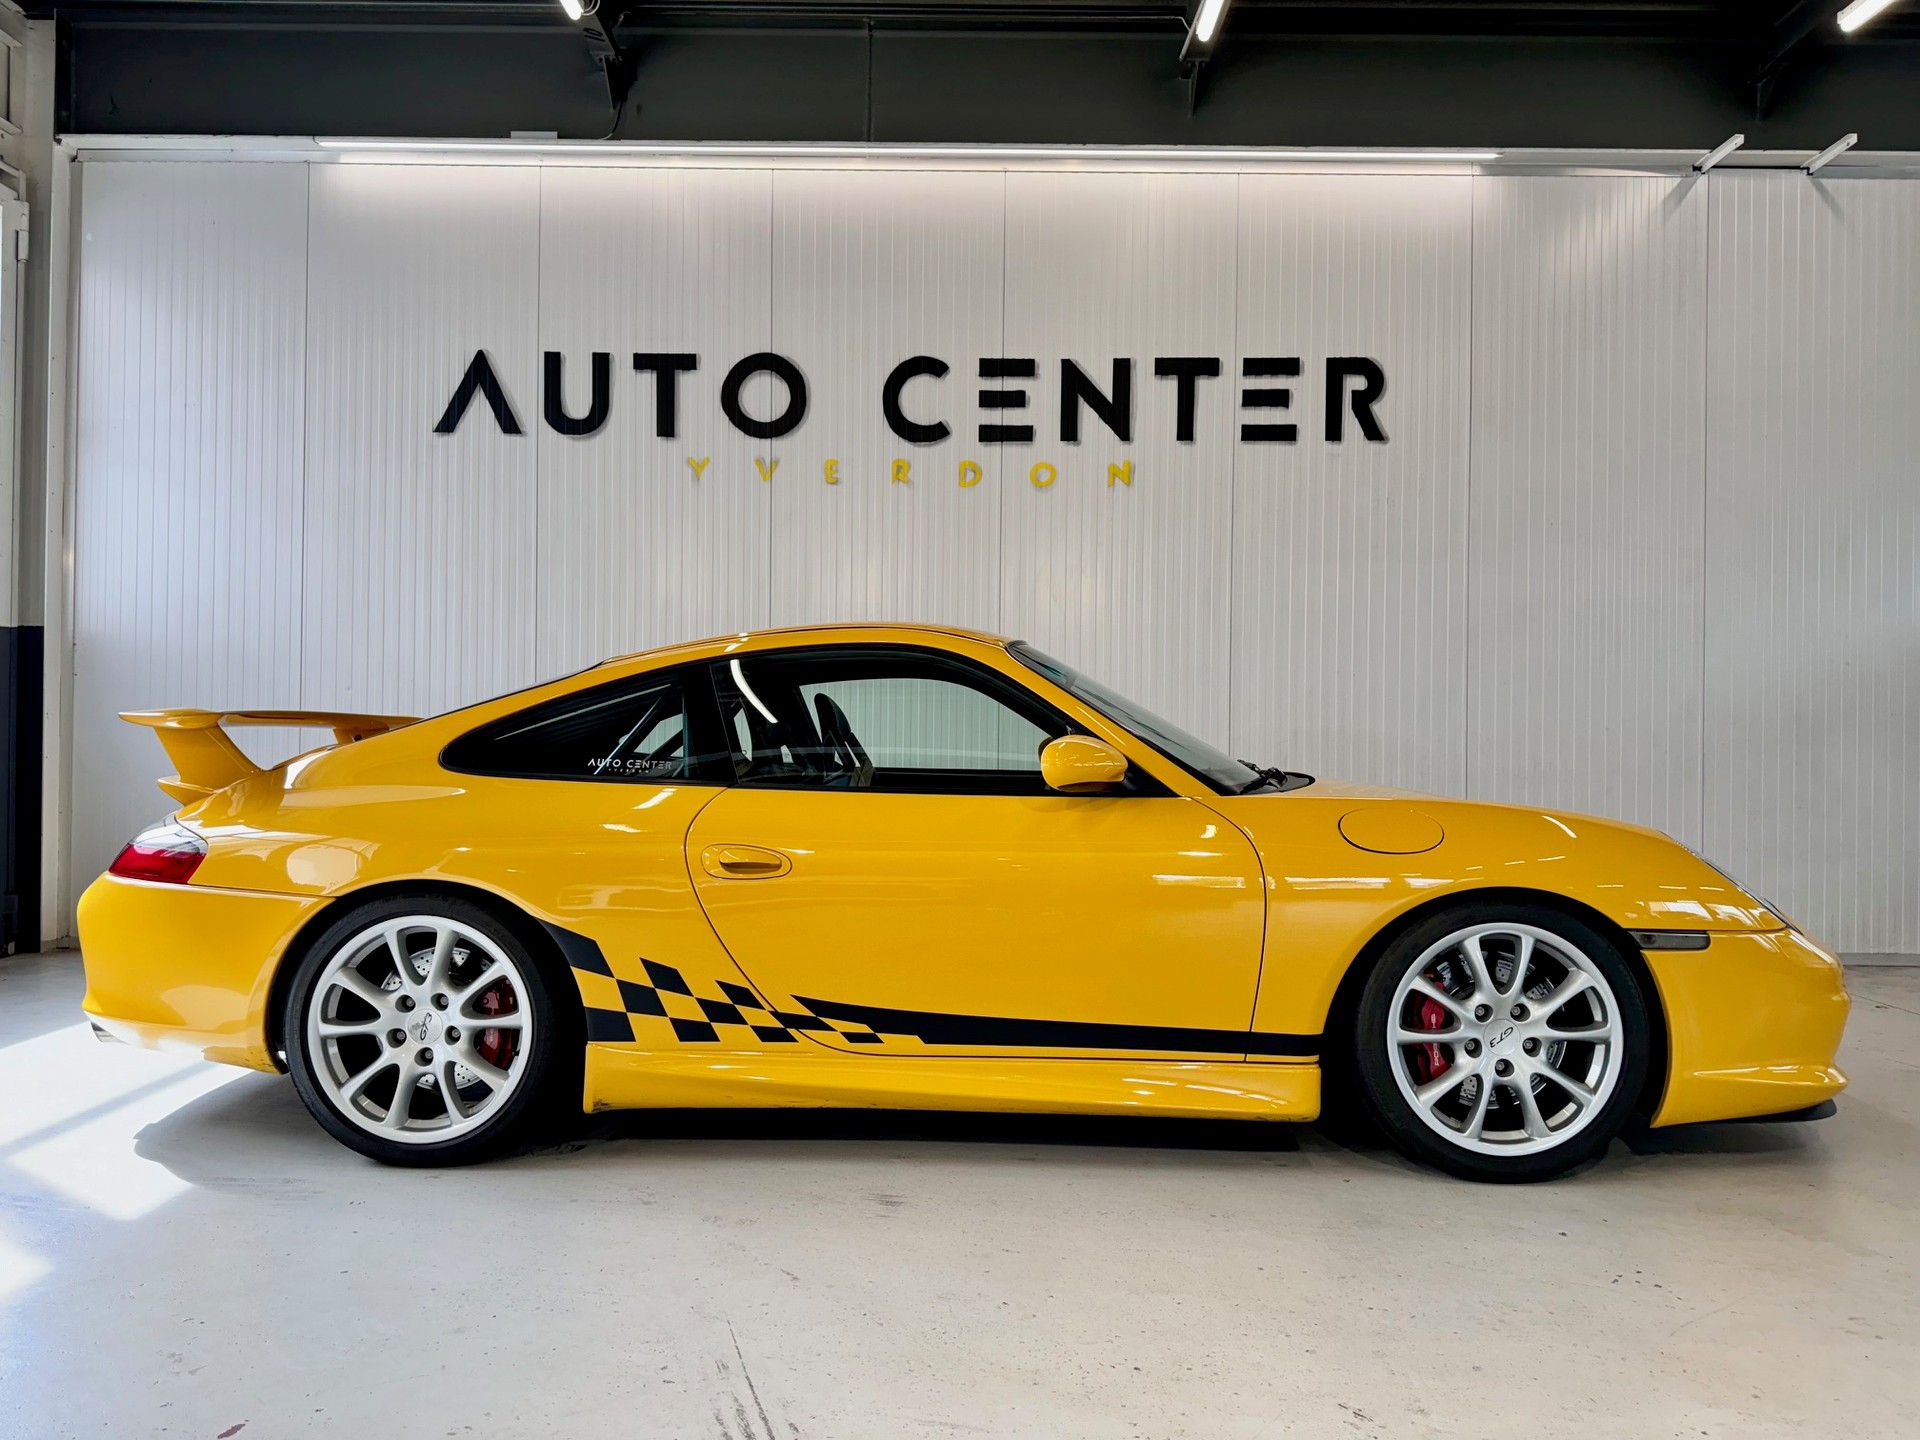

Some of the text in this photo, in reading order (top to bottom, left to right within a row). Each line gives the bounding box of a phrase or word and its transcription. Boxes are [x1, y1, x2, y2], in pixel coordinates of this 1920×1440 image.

[433, 349, 1386, 443] AUTO CENTER
[687, 456, 1133, 488] YVERDON
[587, 758, 672, 770] AUTO CENTER
[1489, 1026, 1514, 1048] GT3
